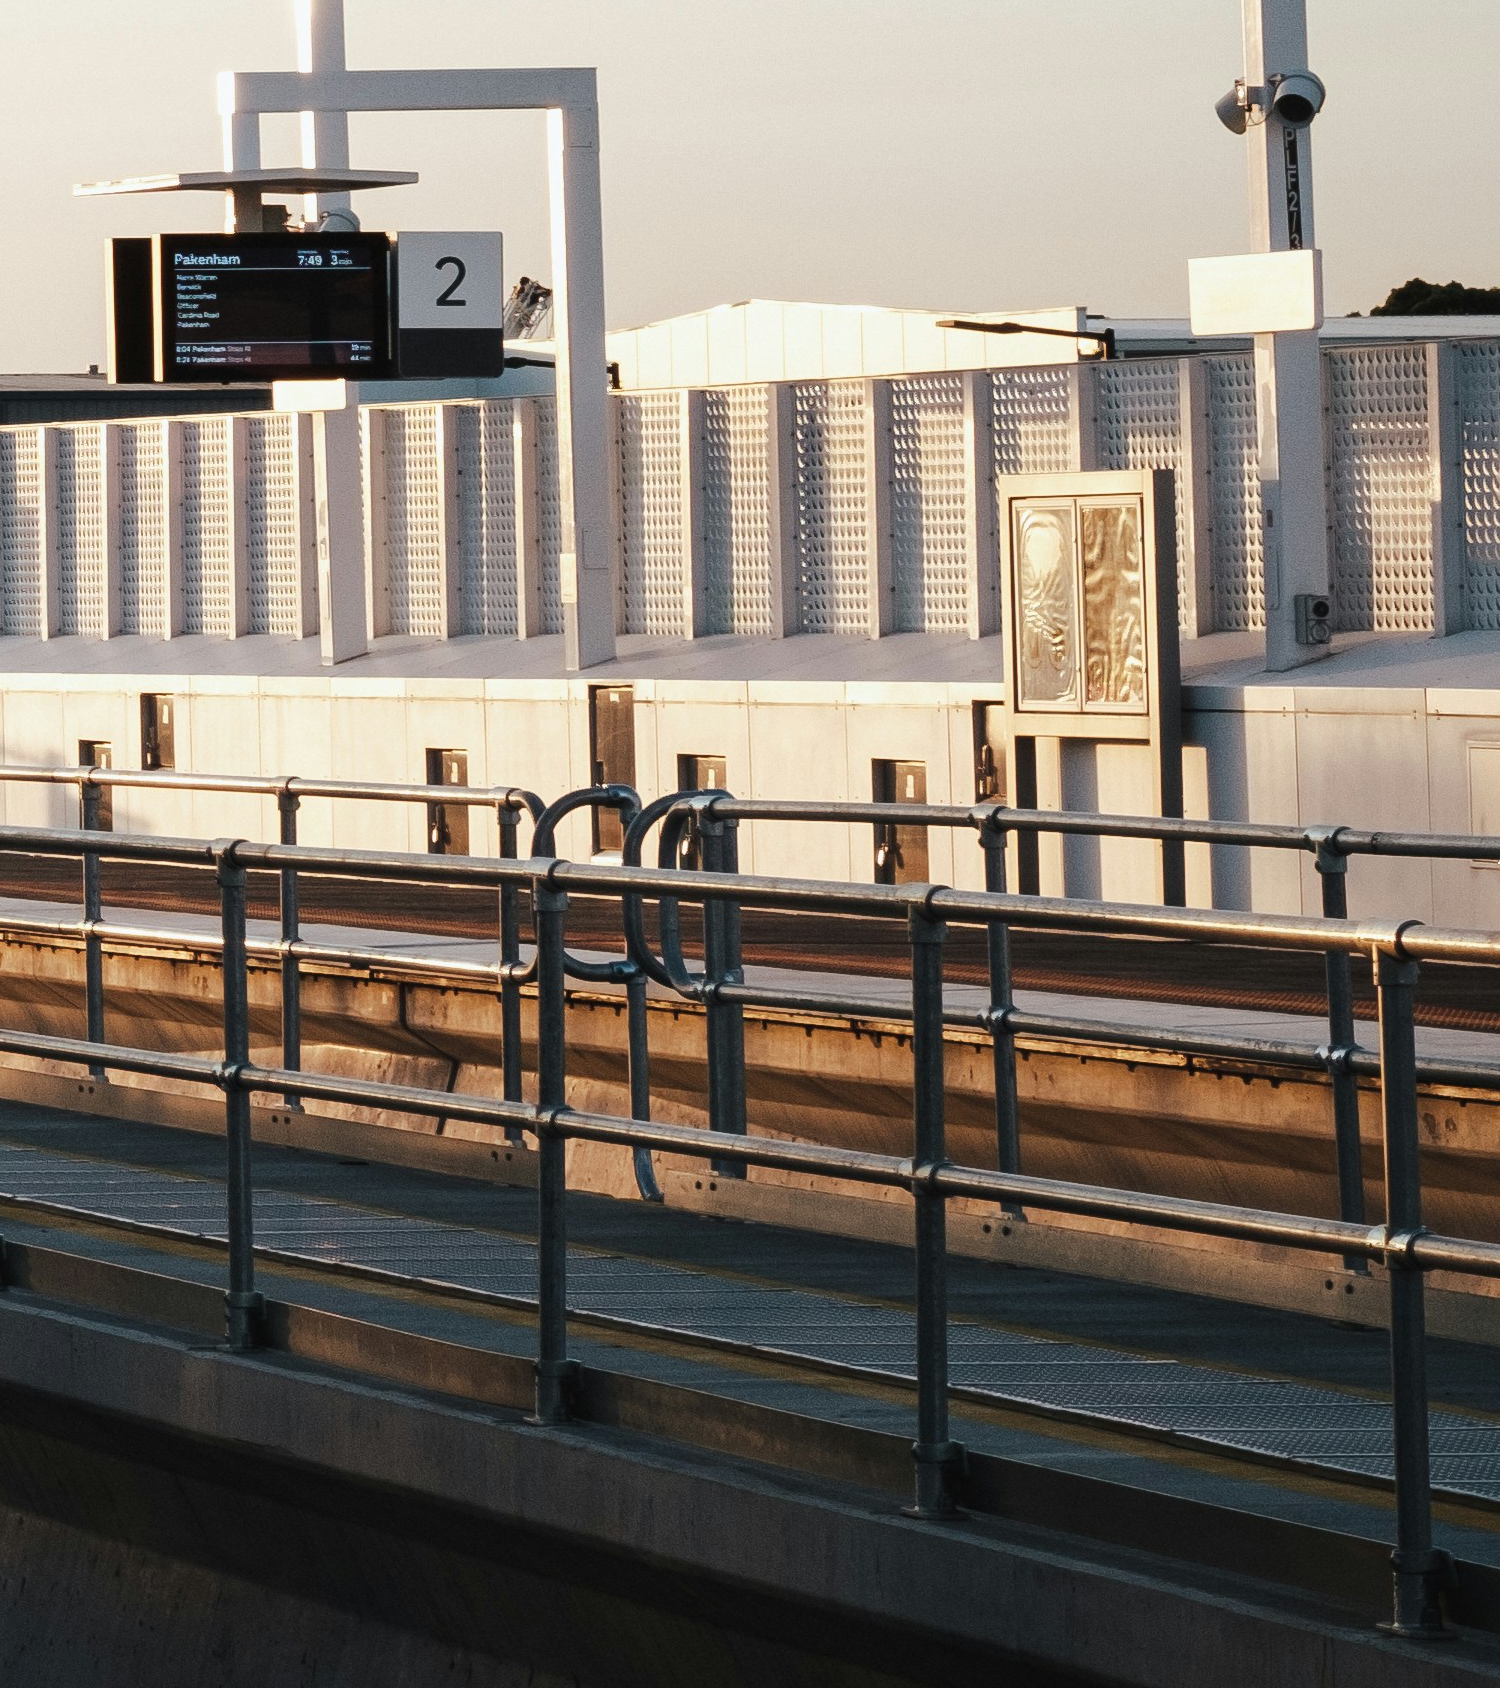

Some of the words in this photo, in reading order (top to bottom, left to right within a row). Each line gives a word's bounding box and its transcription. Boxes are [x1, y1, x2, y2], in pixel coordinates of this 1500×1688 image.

[174, 253, 241, 265] Pakenham
[297, 255, 322, 265] 7:49
[435, 256, 466, 306] 2
